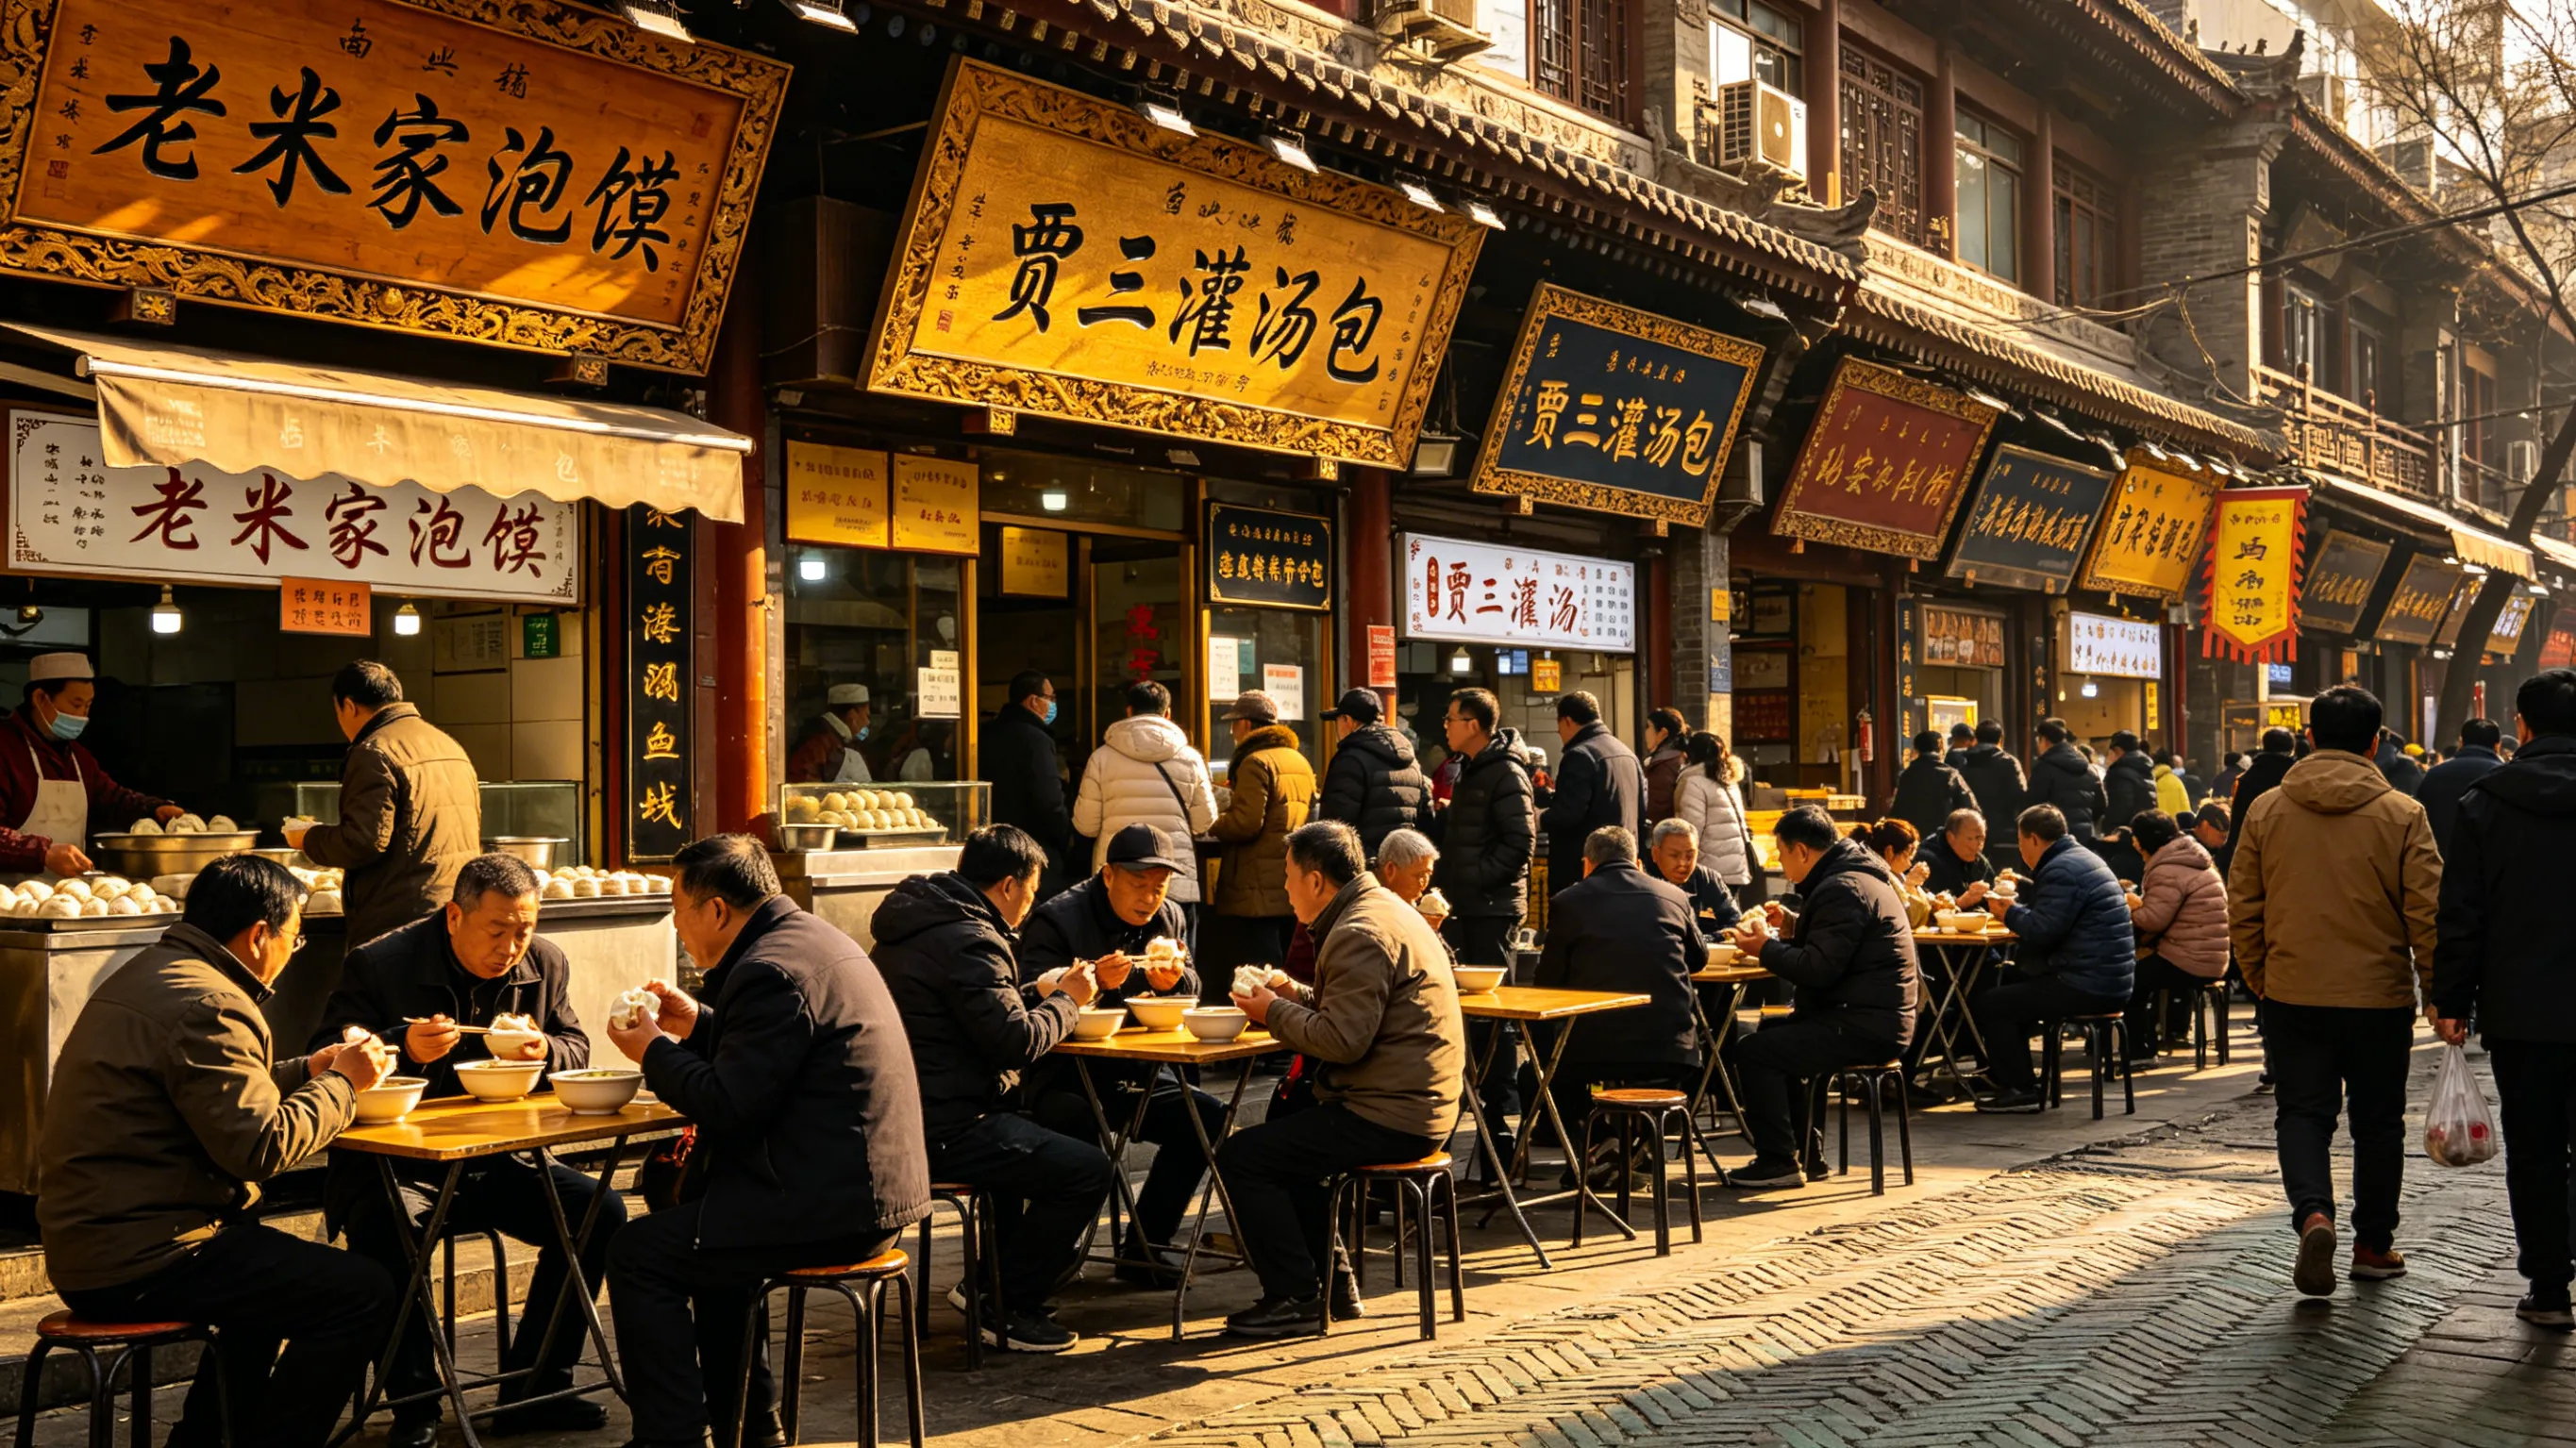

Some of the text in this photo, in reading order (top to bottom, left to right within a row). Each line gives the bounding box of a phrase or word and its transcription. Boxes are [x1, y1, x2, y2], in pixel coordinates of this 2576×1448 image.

[91, 35, 680, 273] 老米家泡馍
[992, 201, 1384, 384] 贾三灌汤包
[1525, 379, 1715, 476] 贾三灌汤包
[129, 466, 548, 579] 老米家泡馍
[1447, 560, 1579, 635] 贾三灌汤
